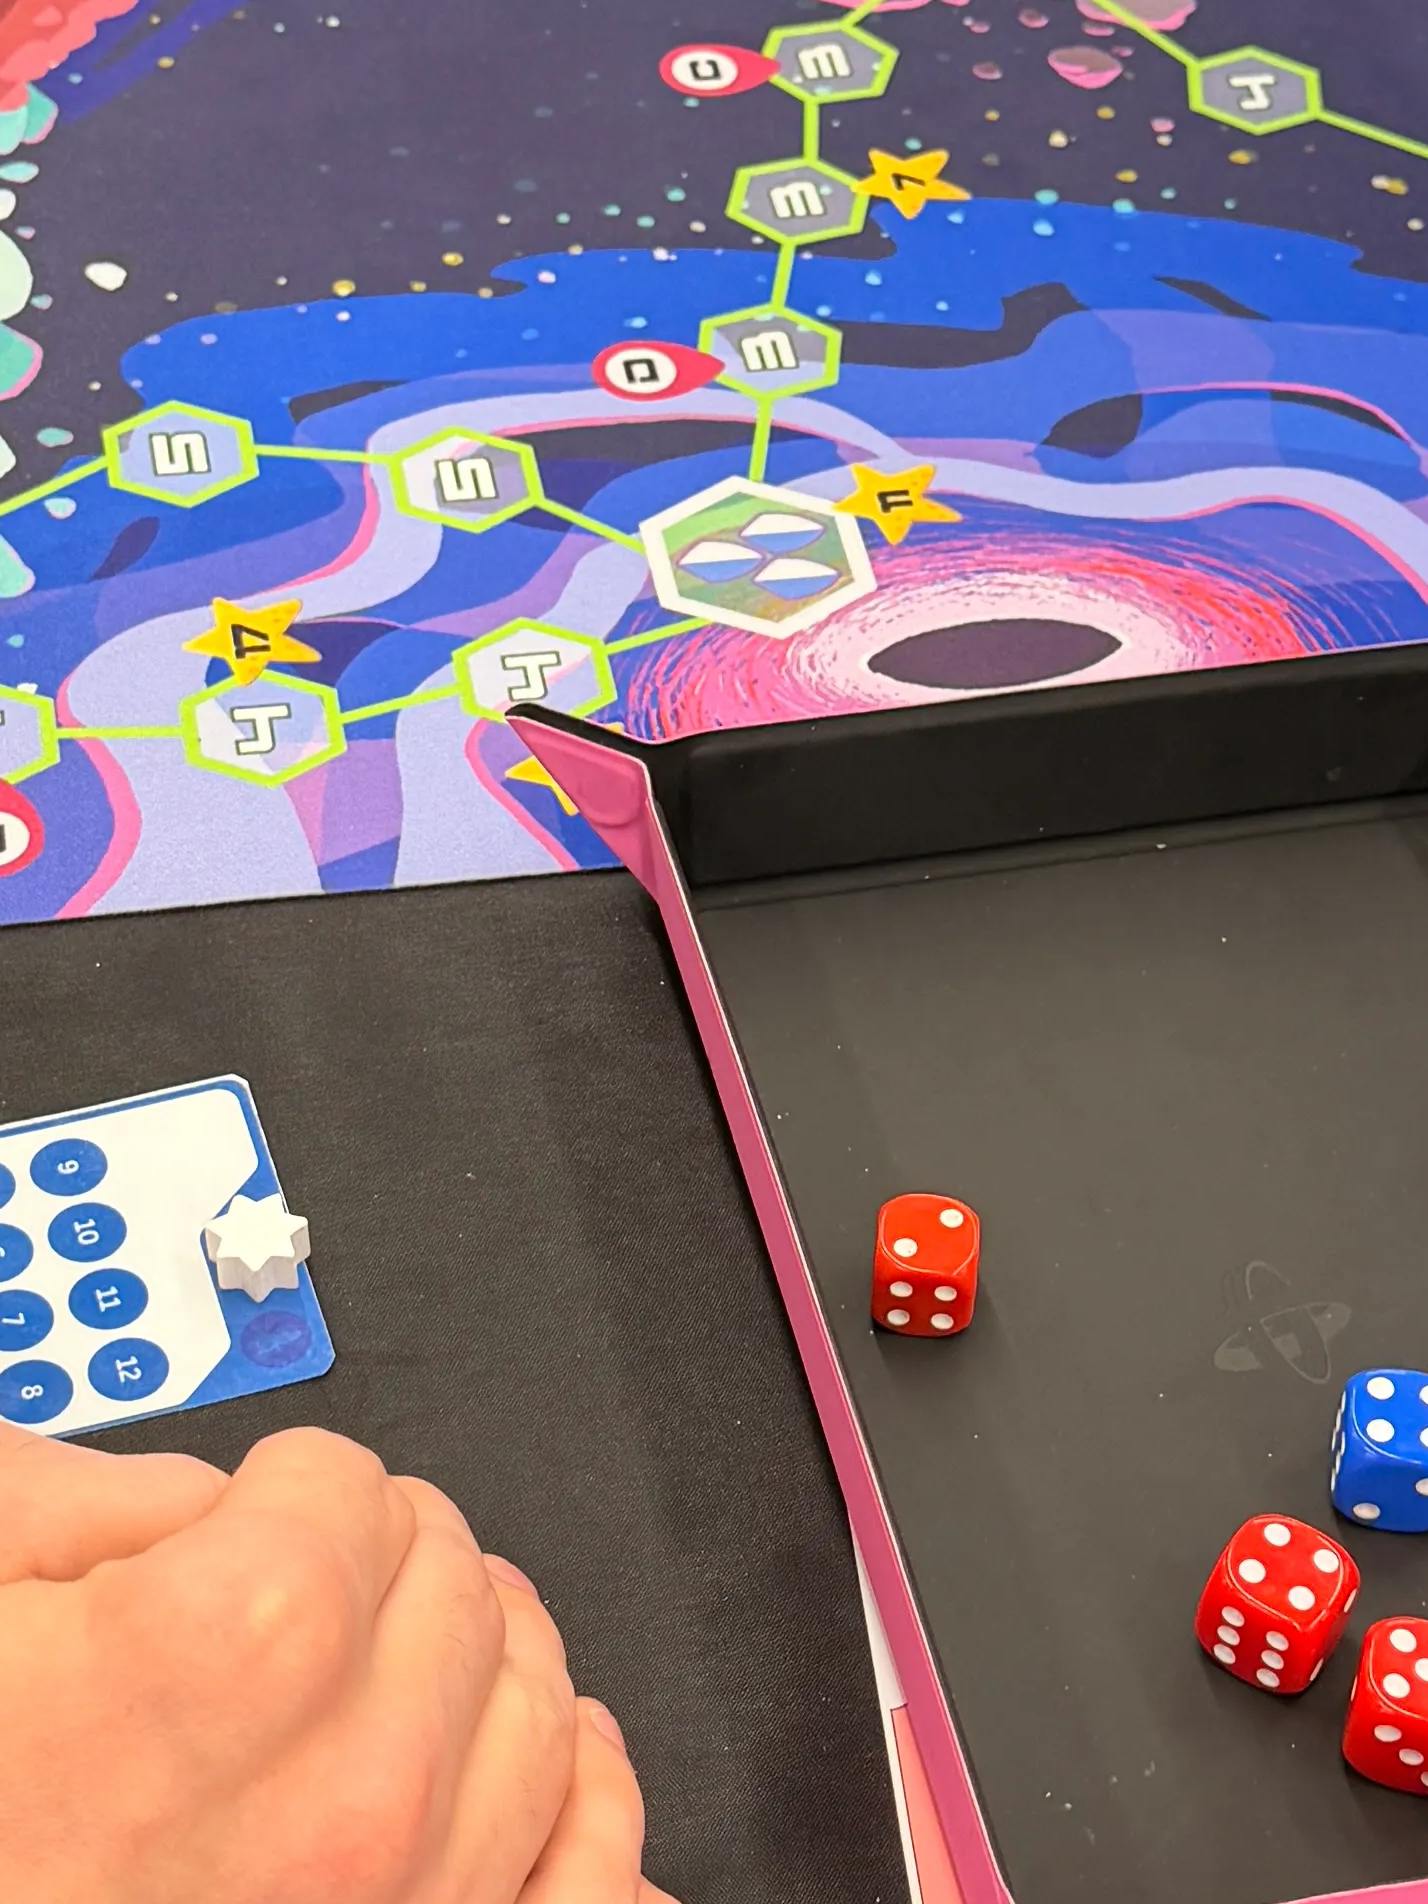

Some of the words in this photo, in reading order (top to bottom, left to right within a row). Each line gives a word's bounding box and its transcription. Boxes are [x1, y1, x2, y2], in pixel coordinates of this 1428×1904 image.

[797, 44, 852, 80] 3
[1227, 73, 1277, 112] 4
[770, 180, 825, 219] 3
[741, 332, 797, 373] 3
[622, 358, 659, 384] D
[150, 431, 211, 478] 5
[436, 456, 500, 503] 5
[232, 623, 273, 660] 17
[500, 650, 562, 702] 4
[233, 704, 293, 757] 4
[57, 1158, 80, 1175] 9
[73, 1218, 100, 1247] 10
[95, 1285, 122, 1313] 11
[1, 1312, 25, 1327] 7
[113, 1355, 142, 1382] 12
[21, 1383, 44, 1401] 8
